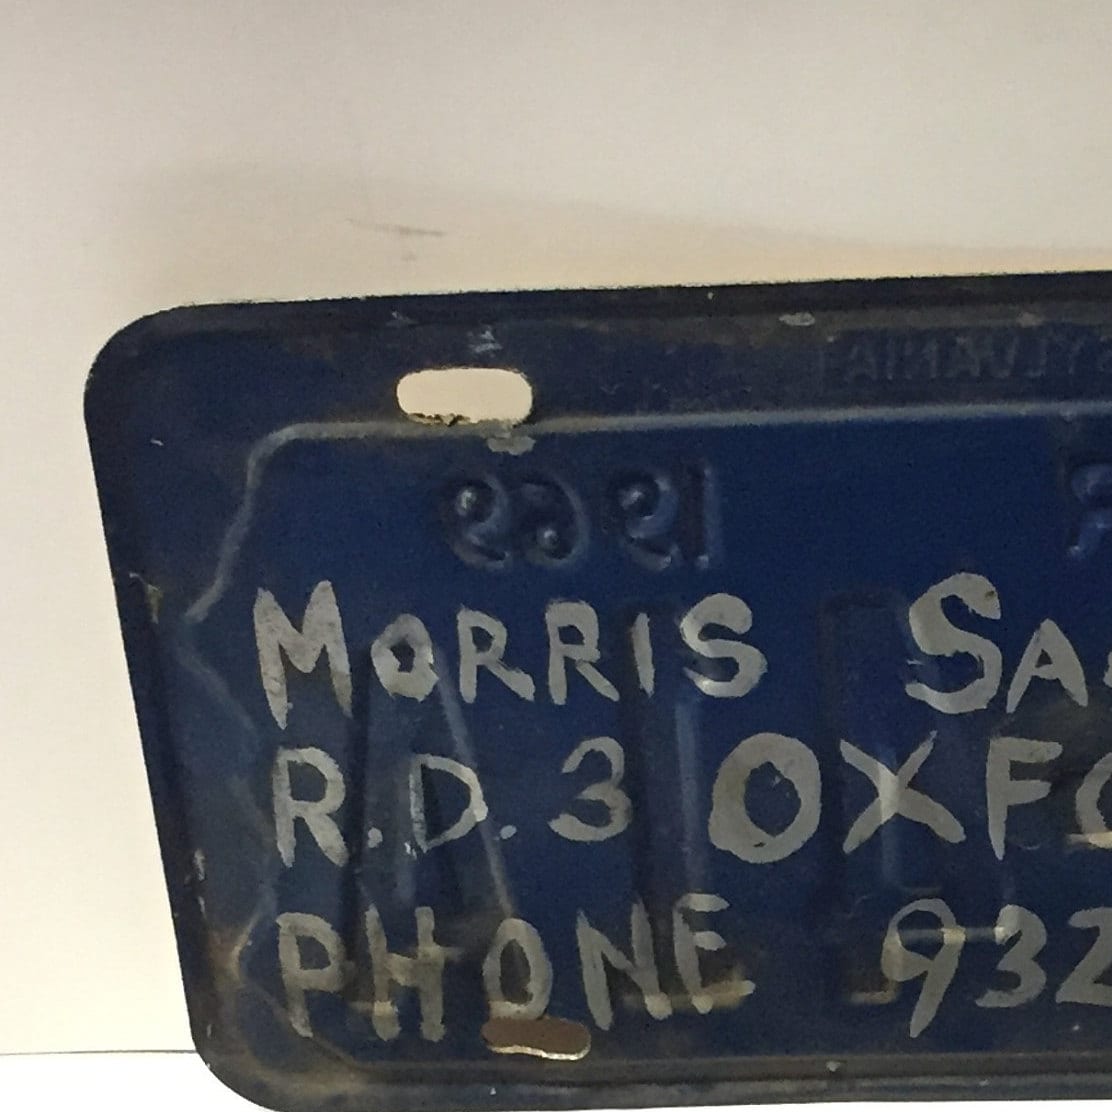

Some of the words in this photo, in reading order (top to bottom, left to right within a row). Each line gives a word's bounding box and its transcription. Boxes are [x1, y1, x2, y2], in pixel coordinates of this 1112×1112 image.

[253, 578, 768, 730] MORRIS
[547, 736, 634, 843] 3
[275, 892, 757, 1042] PHONE
